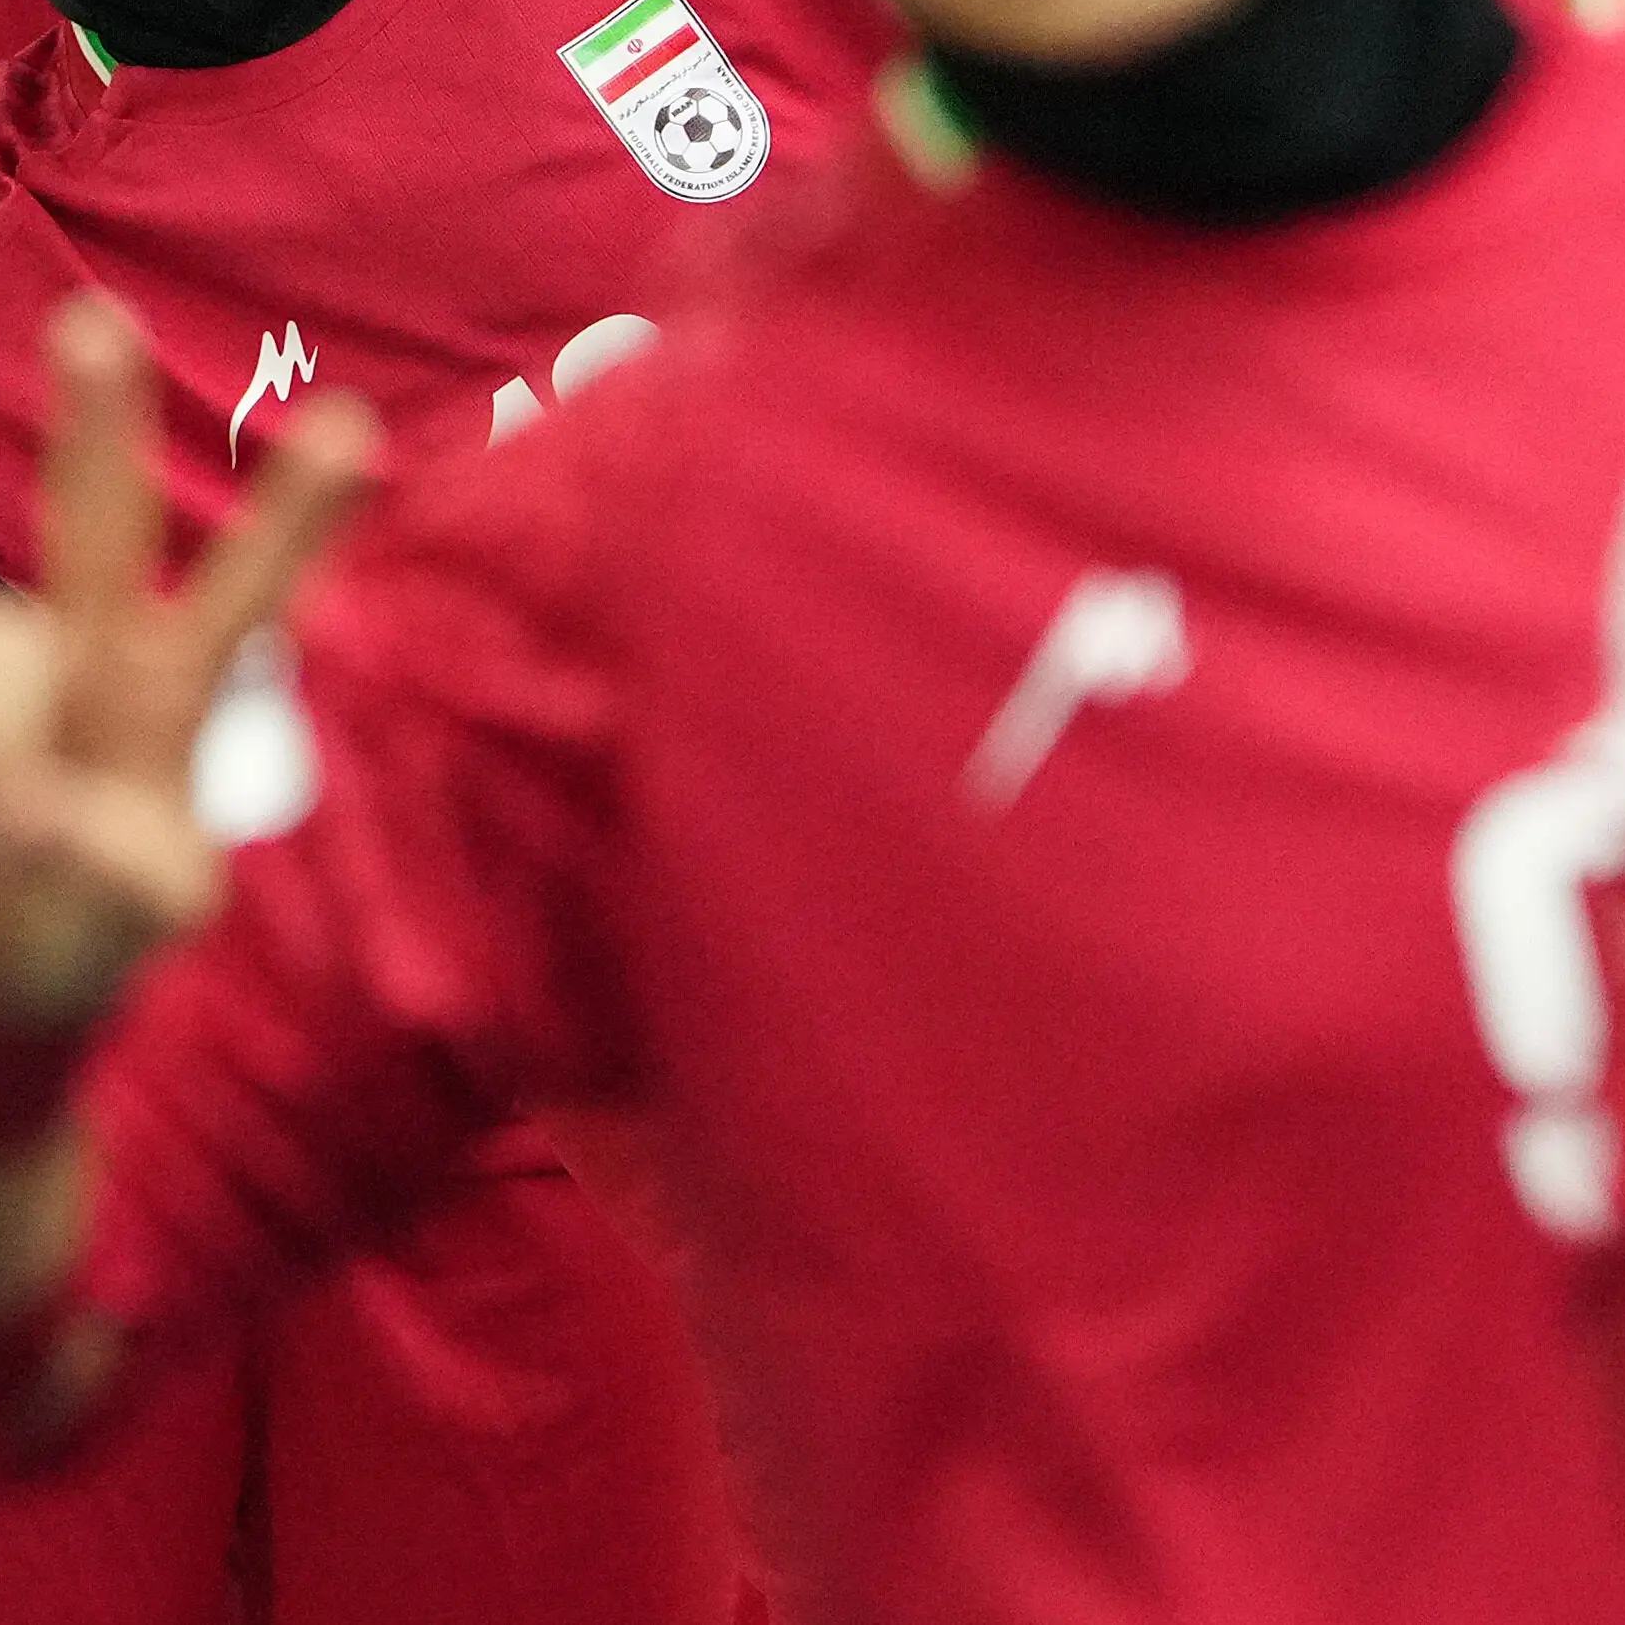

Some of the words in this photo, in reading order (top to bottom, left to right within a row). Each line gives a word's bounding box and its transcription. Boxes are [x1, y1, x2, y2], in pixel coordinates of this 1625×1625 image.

[716, 65, 734, 88] IRAN
[671, 100, 693, 117] IRAN
[627, 129, 664, 176] FOOTBALL
[725, 149, 756, 183] ISLAMIC
[663, 173, 724, 190] FEDERATION
